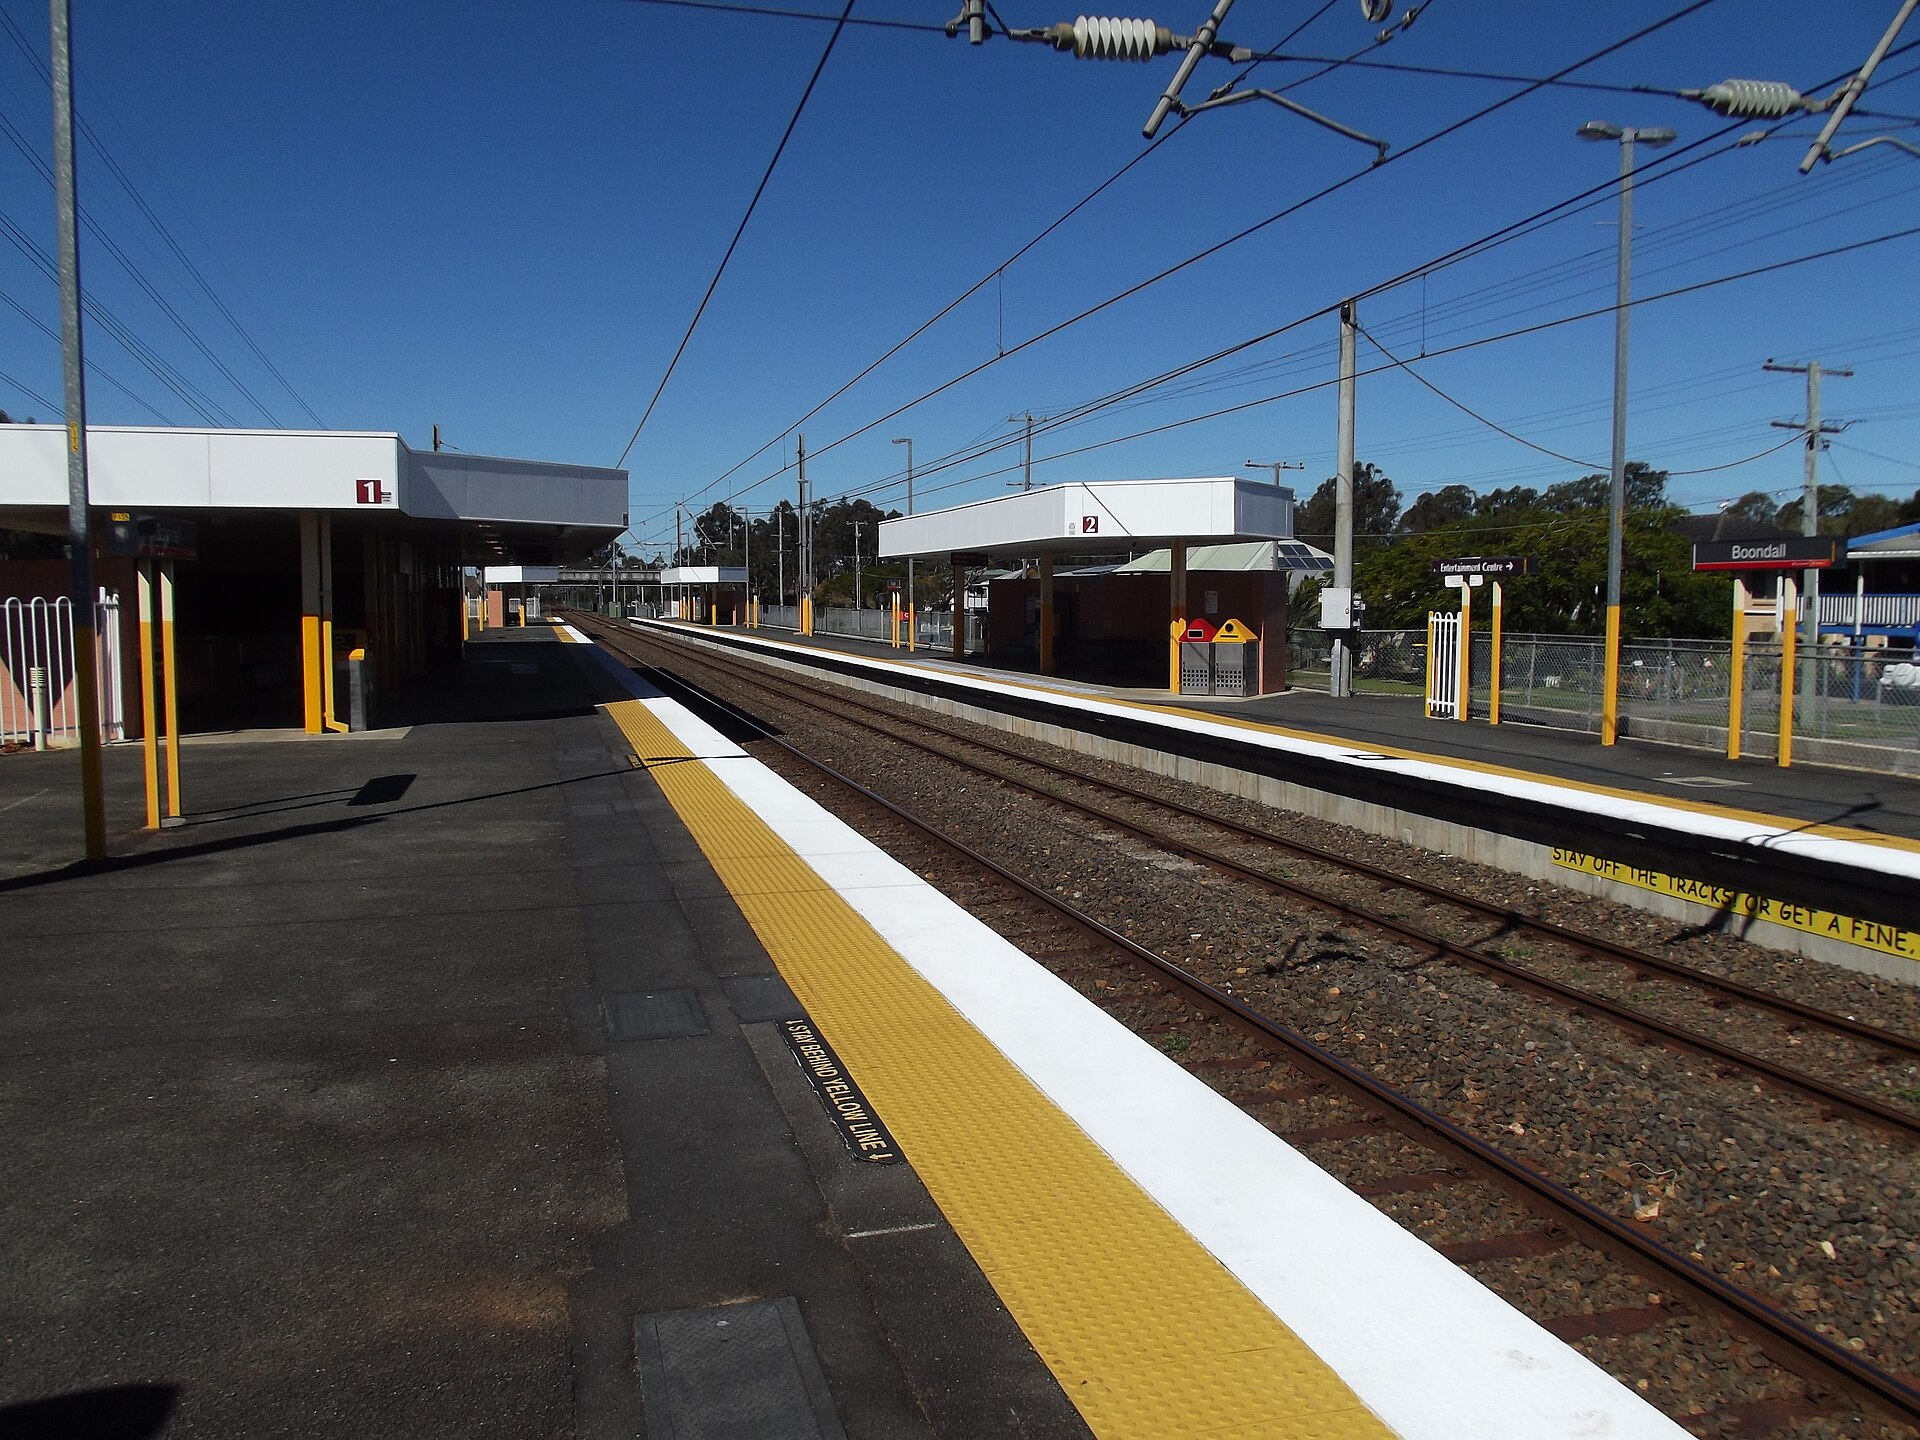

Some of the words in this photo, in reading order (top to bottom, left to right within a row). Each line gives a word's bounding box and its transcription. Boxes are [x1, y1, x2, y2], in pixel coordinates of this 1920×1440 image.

[363, 481, 374, 502] 1
[1085, 516, 1096, 533] 2
[1732, 543, 1787, 559] Boondall
[1440, 562, 1481, 573] Entertainment
[1482, 561, 1504, 572] Centre
[1552, 848, 1585, 866] STAY
[1593, 857, 1620, 876] OFF
[1629, 866, 1658, 887] THE
[1745, 892, 1770, 916] OR
[1780, 902, 1818, 927] GET
[1827, 916, 1841, 934] A
[789, 1024, 818, 1044] STAY
[800, 1044, 839, 1078] BEHIND
[823, 1077, 868, 1121] YELLOW
[849, 1122, 888, 1151] LINE
